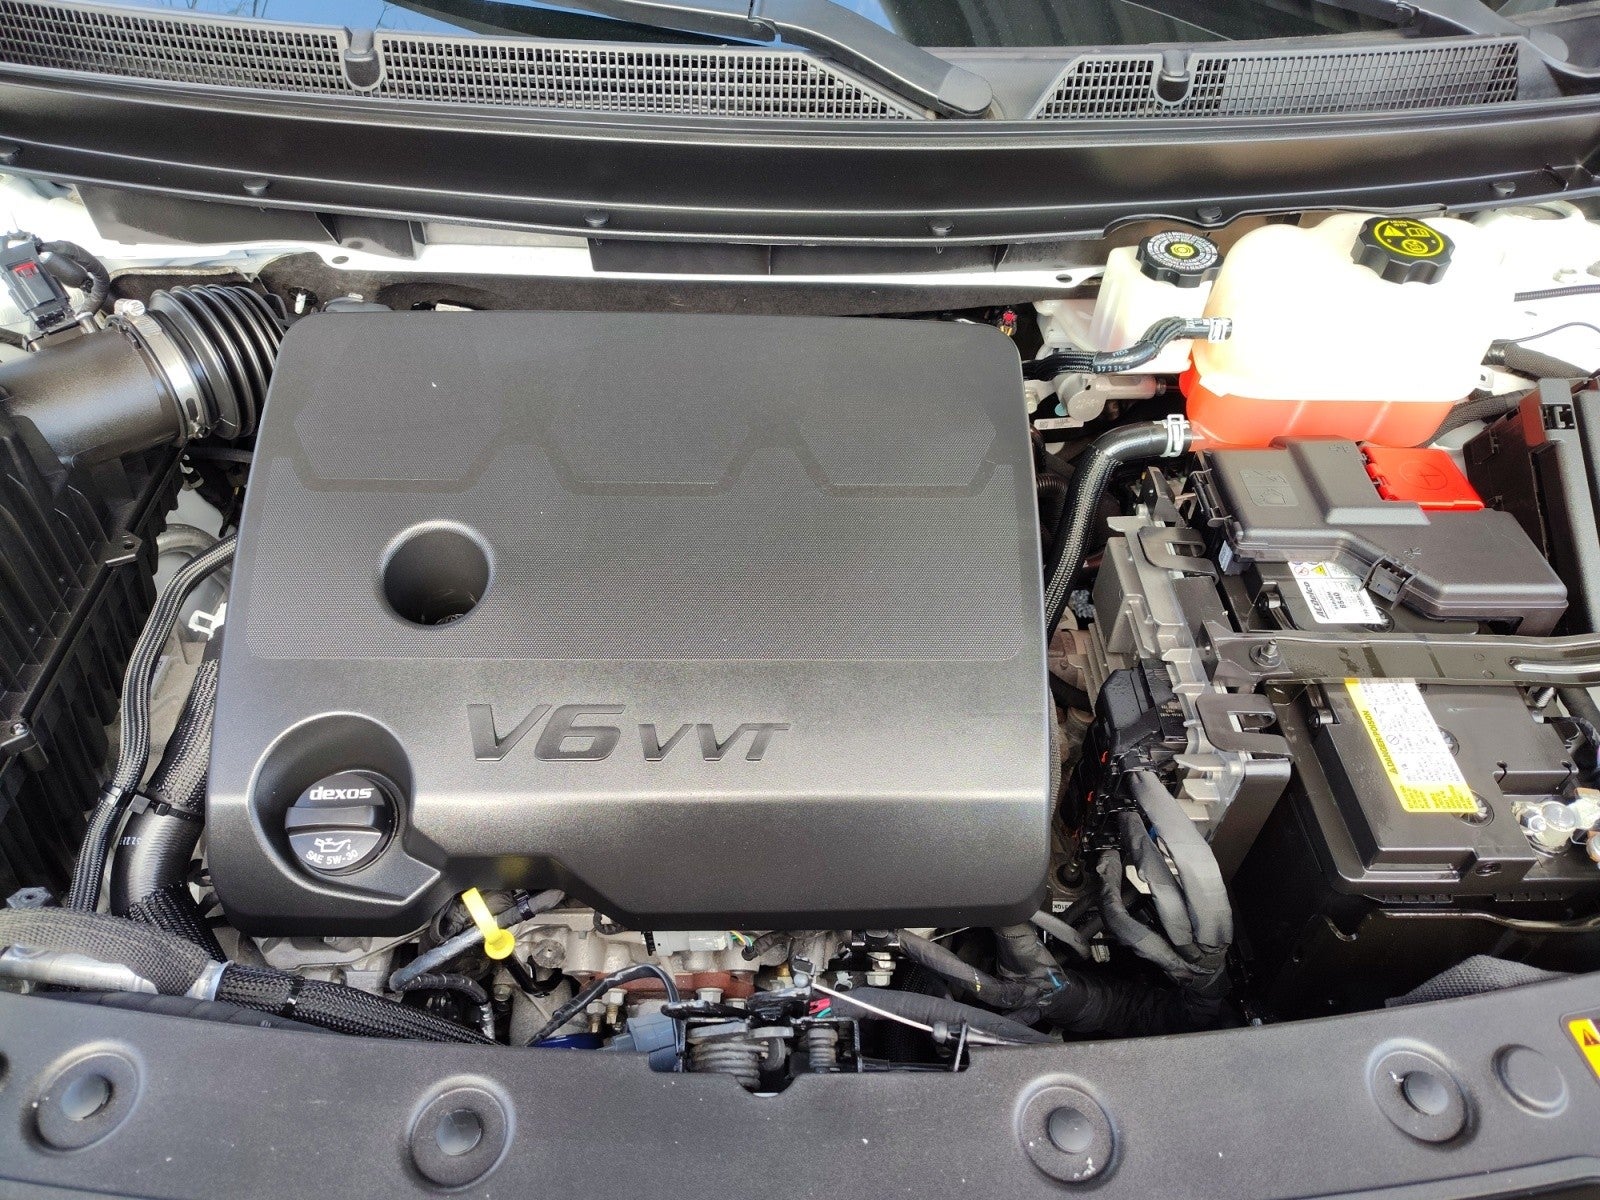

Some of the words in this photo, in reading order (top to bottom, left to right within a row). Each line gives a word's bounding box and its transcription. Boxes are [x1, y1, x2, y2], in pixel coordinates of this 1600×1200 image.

[1303, 581, 1326, 618] ACDelco
[467, 704, 626, 762] V6
[637, 723, 791, 762] VVT
[1362, 710, 1395, 769] DANGER/POISON
[309, 786, 375, 801] dexos
[305, 850, 325, 865] SAE
[326, 849, 359, 865] 5W-30
